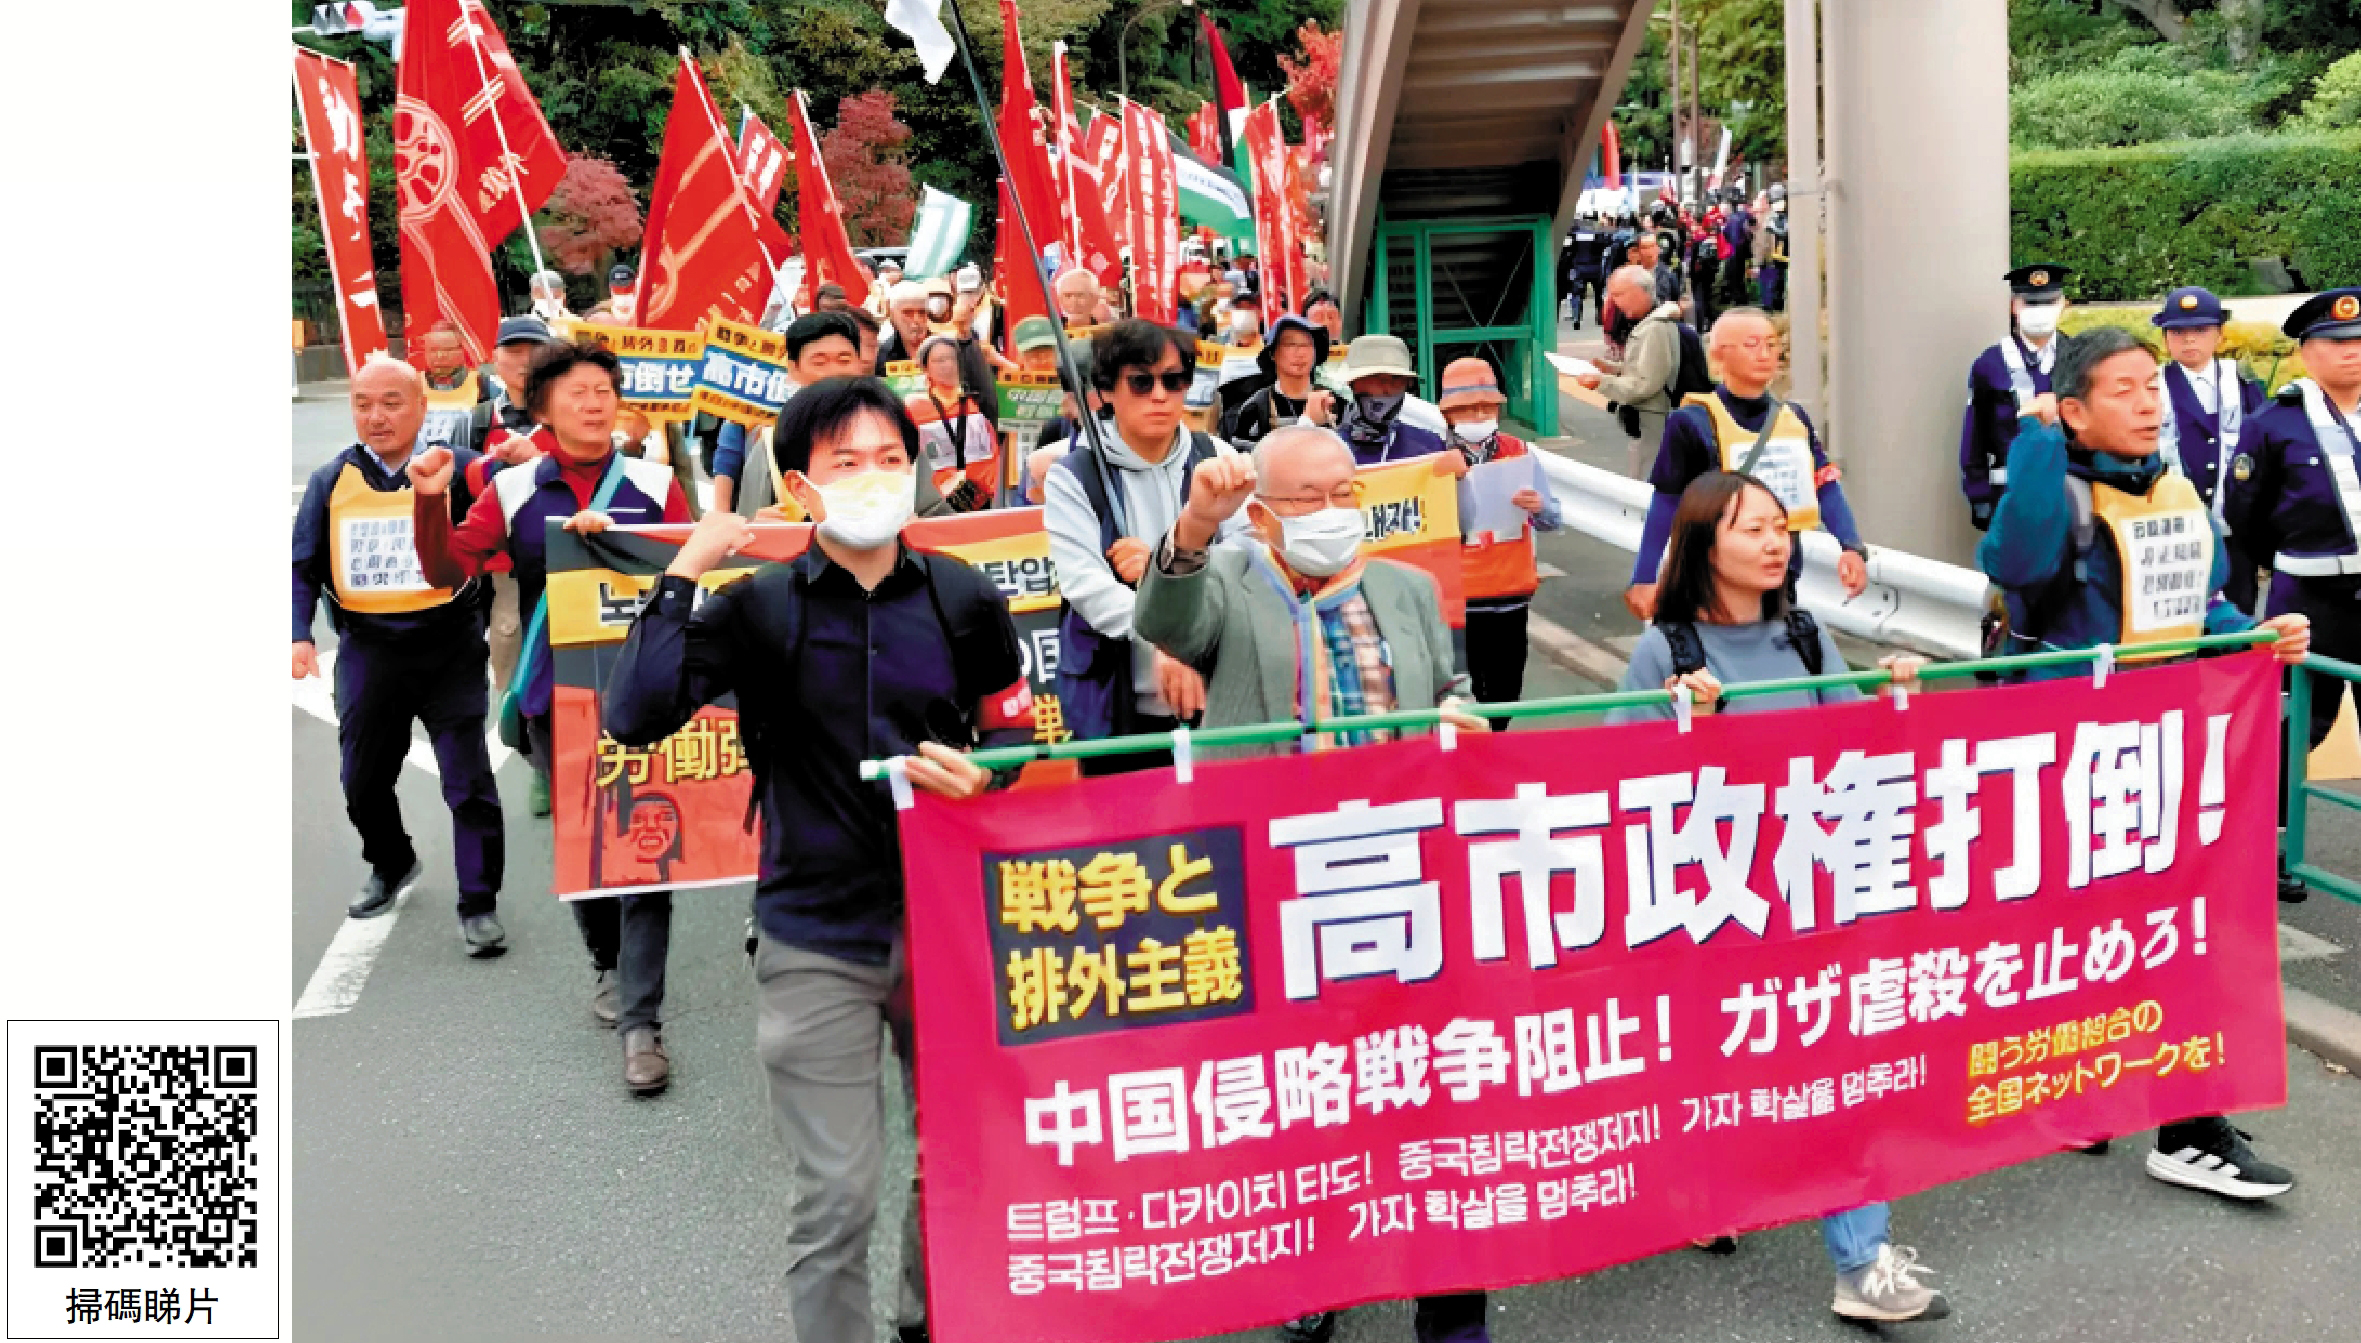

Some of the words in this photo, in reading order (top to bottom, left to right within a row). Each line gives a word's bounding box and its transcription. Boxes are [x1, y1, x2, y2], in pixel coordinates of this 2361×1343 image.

[998, 842, 1219, 935] 戦争と
[1267, 708, 2233, 1002] 高市政権打倒！
[1006, 924, 1244, 1031] 排外主義
[1023, 995, 1673, 1167] 中国侵略戦争阻止！
[1719, 896, 2208, 1058] ガザ虐殺を止めろ！
[1968, 999, 2164, 1079] 闘う労働組合の
[1294, 1150, 1374, 1205] 타도!
[1680, 1091, 1744, 1133] 가자
[1348, 1192, 1416, 1242] 가자
[1425, 1182, 1529, 1231] 학살을
[1536, 1161, 1639, 1222] 멈추라!
